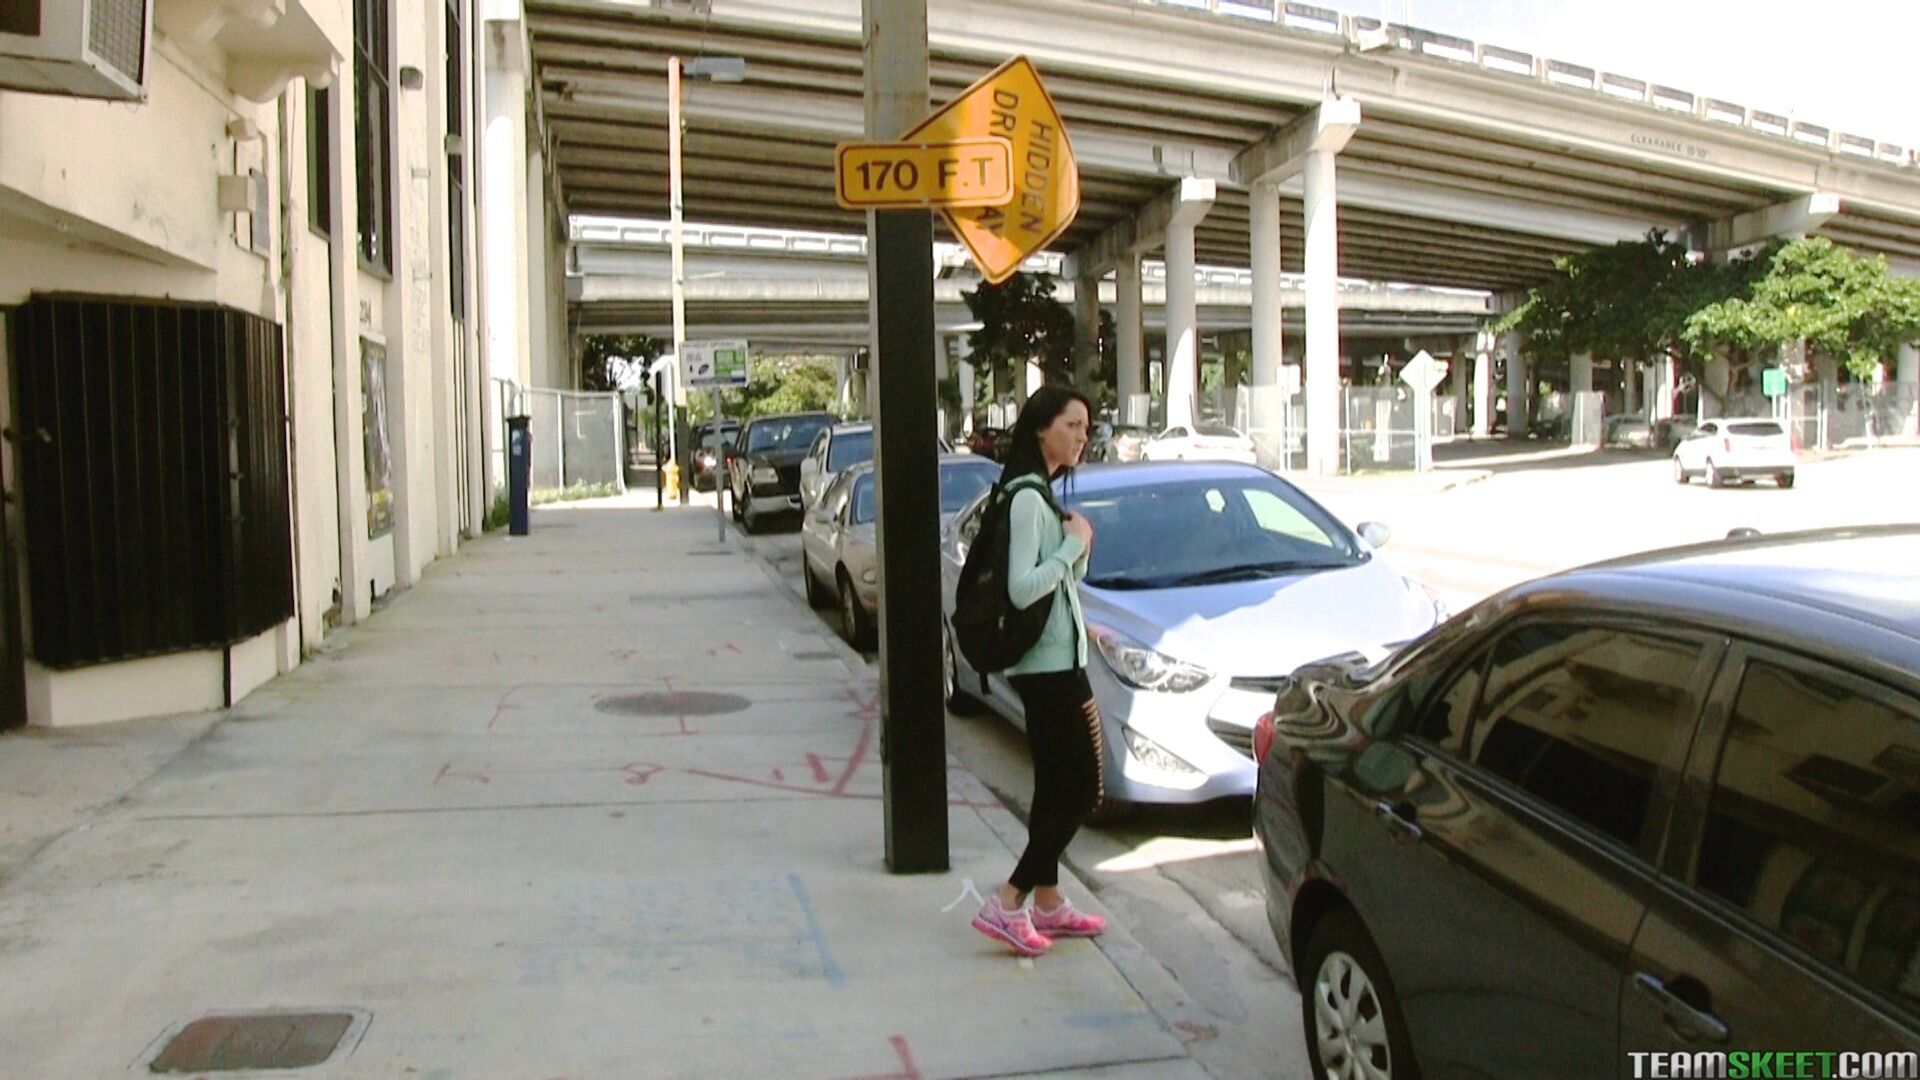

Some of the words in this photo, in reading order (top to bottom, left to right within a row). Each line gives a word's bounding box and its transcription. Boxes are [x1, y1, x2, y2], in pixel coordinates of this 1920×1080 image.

[856, 160, 918, 190] 170
[938, 157, 993, 189] F.T
[976, 89, 1018, 236] DRIAY
[1020, 119, 1052, 233] HIDDEN
[1631, 134, 1682, 152] CLEARANCE
